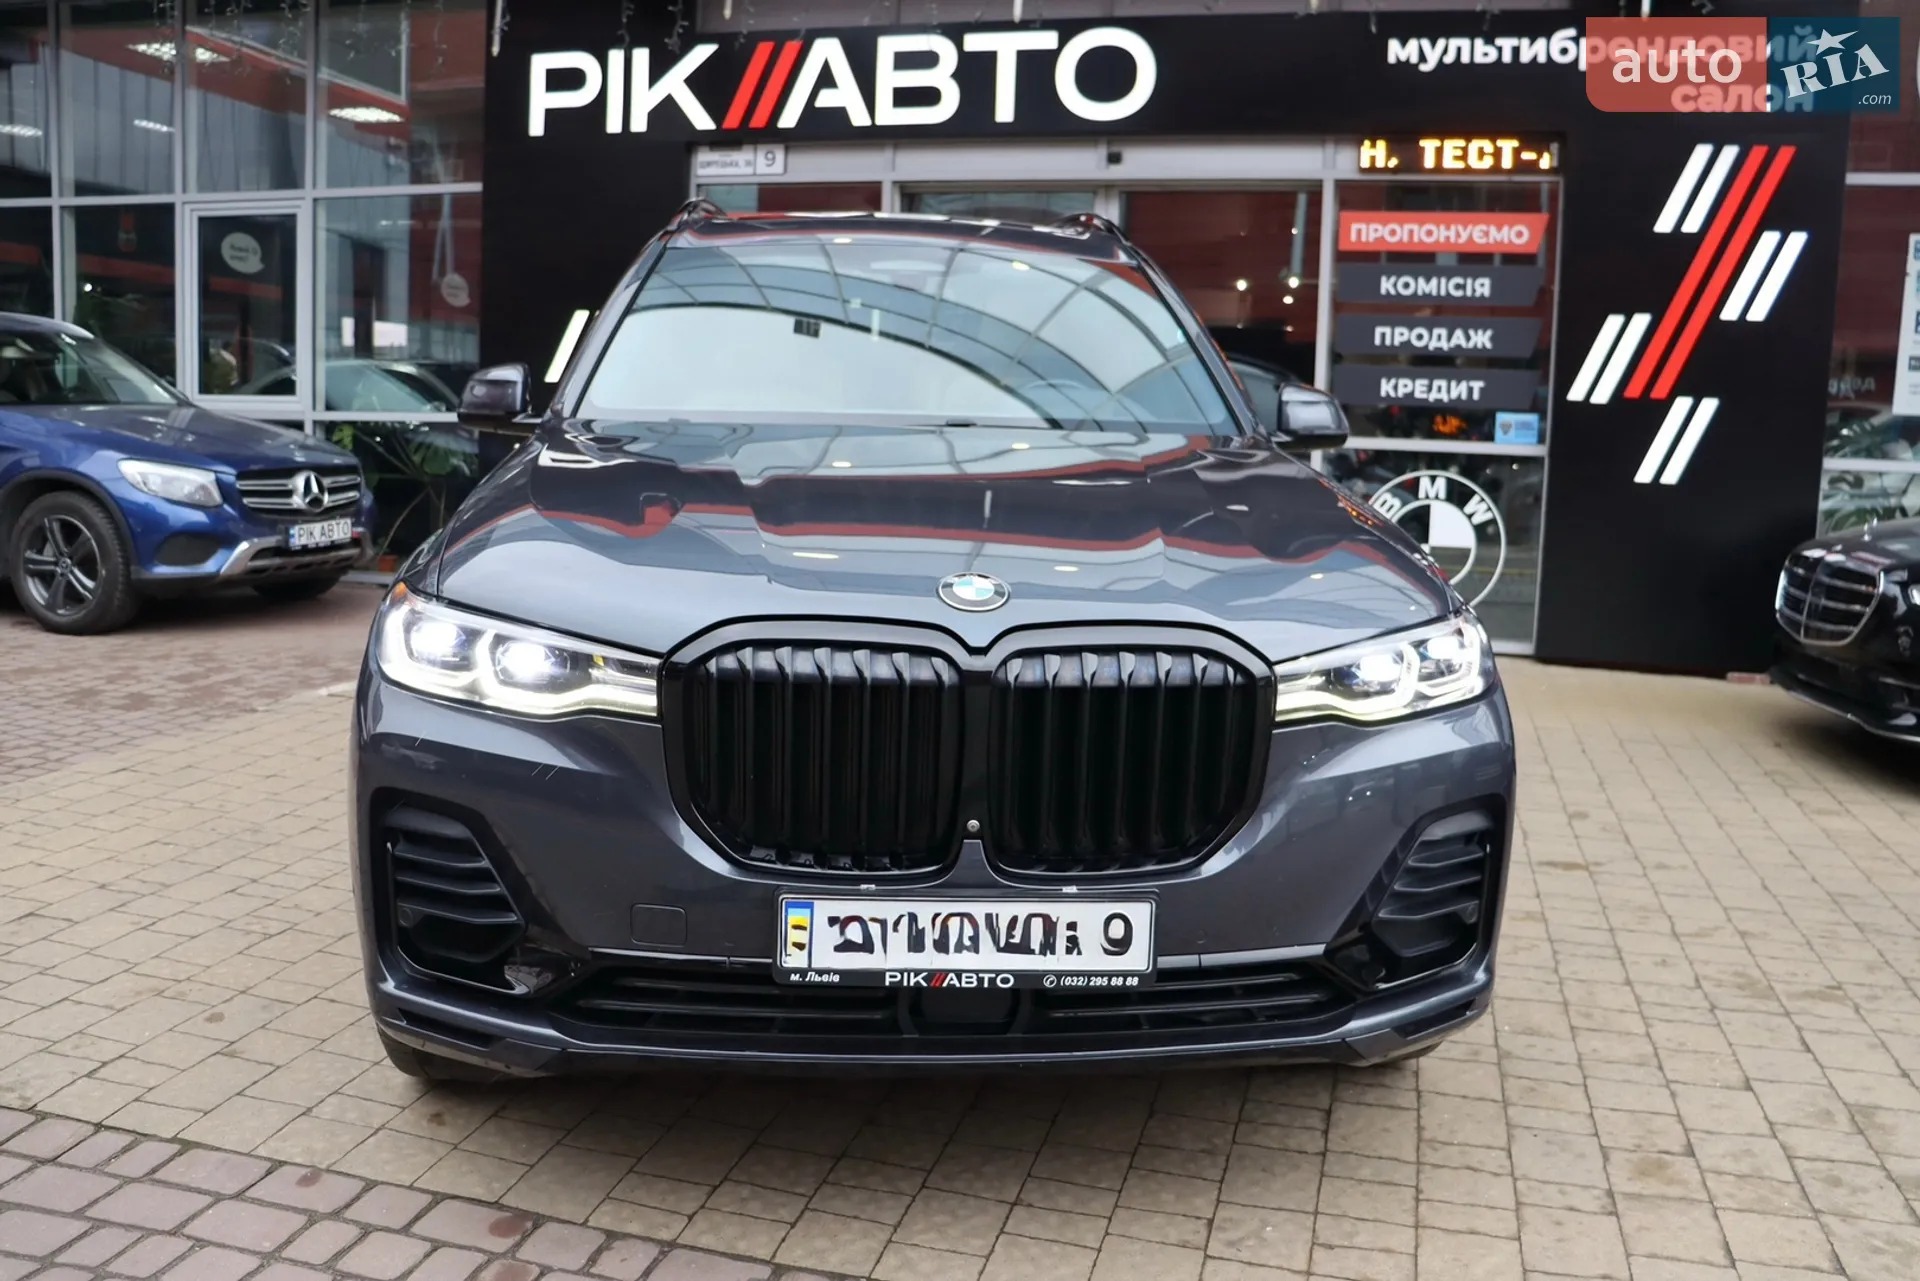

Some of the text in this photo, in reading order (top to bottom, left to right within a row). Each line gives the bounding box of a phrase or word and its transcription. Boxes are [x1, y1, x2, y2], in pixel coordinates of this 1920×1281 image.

[1671, 84, 1814, 113] салон
[764, 151, 776, 168] 9
[1350, 222, 1530, 245] ПРОПОНУЄМО
[1379, 275, 1492, 298] КОМІСІЯ
[1373, 325, 1493, 352] ПРОДАЖ
[1379, 377, 1486, 403] КРЕДИТ
[1372, 475, 1495, 527] BMW
[805, 972, 841, 983] Львів
[1060, 976, 1140, 987] (032) 295 88 88
